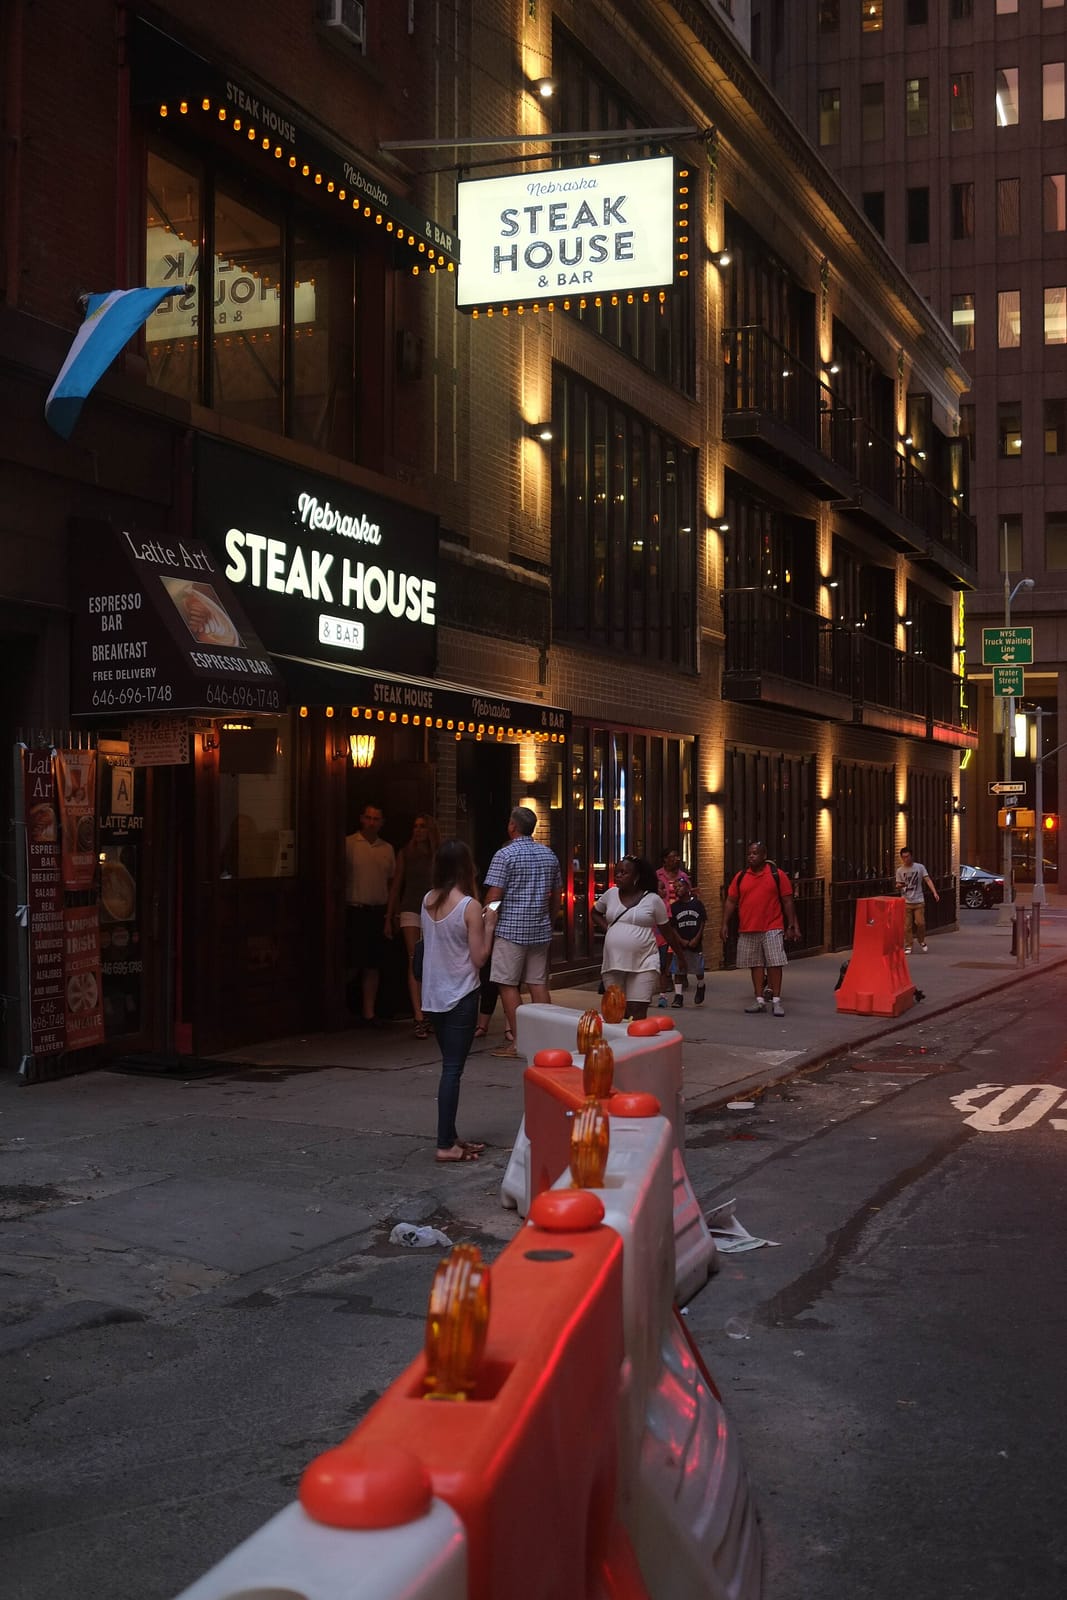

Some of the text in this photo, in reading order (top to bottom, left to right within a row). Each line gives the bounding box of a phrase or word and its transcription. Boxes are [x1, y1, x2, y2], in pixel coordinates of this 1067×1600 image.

[226, 81, 296, 144] STEAK HOUSE
[344, 162, 389, 207] Nebraska
[526, 177, 599, 196] Nebraska
[500, 195, 628, 237] STEAK
[425, 221, 452, 252] & BAR
[493, 231, 634, 273] HOUSE
[538, 271, 593, 288] & BAR
[298, 492, 381, 545] Nebraska
[122, 531, 215, 573] Latte Art
[225, 528, 436, 625] STEAK HOUSE
[89, 592, 141, 614] ESPRESSO
[101, 613, 123, 631] BAR
[323, 622, 359, 644] & BAR
[92, 641, 148, 661] BREAKFAST
[1005, 637, 1031, 646] Waiting
[93, 667, 157, 682] FREE DELIVERY
[189, 651, 273, 676] ESPRESSO BAR
[998, 669, 1018, 677] Water
[92, 685, 173, 707] 646-696-1748
[206, 684, 280, 708] 646-696-1748
[373, 683, 433, 710] STEAK HOUSE
[472, 696, 512, 720] Nebraska
[541, 711, 565, 729] & BAR
[117, 778, 129, 801] A
[100, 816, 144, 829] LATTE ART
[37, 953, 62, 965] WRAPS
[40, 1034, 57, 1044] FREE
